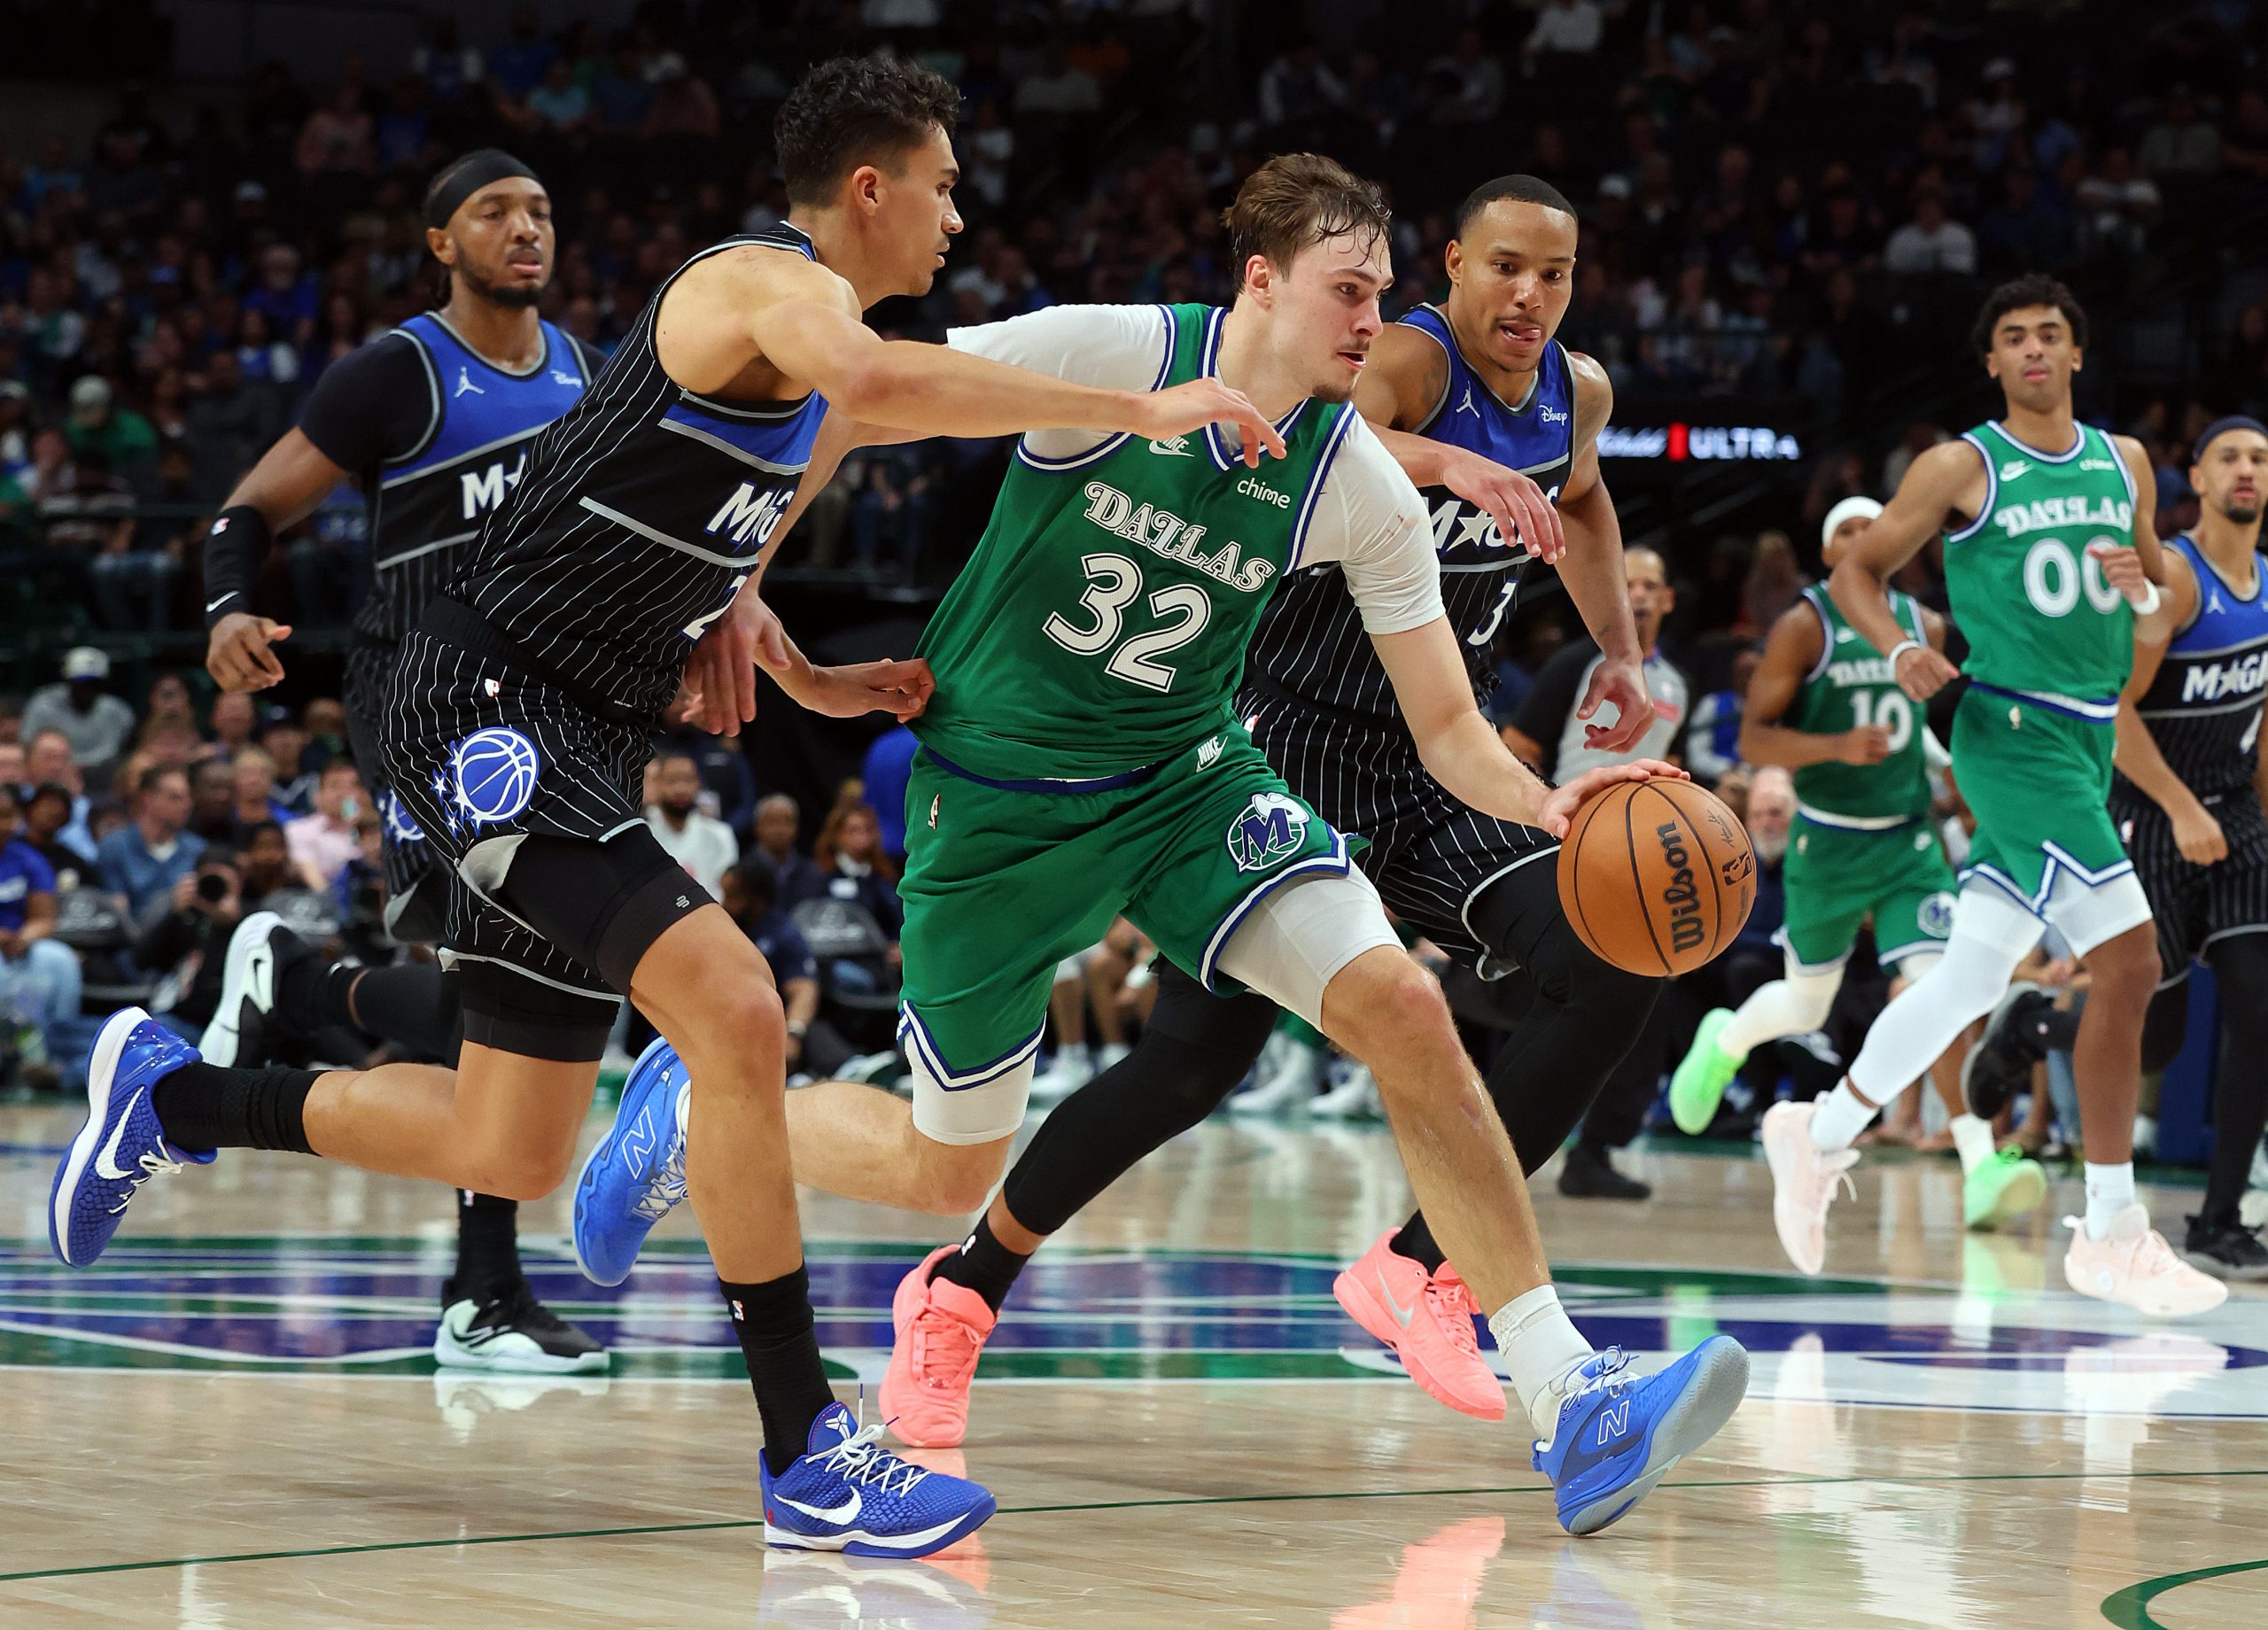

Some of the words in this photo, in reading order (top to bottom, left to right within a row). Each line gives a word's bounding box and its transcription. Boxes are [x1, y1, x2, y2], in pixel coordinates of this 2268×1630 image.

[1237, 477, 1291, 509] chime
[1994, 495, 2132, 539] DALLAS
[1084, 481, 1277, 593] DALLAS
[2023, 534, 2122, 617] 00
[1042, 553, 1212, 694] 32
[1197, 735, 1221, 765] NIKE
[1850, 688, 1913, 753] 10
[1656, 819, 1705, 955] Wilson
[1597, 1400, 1629, 1446] N
